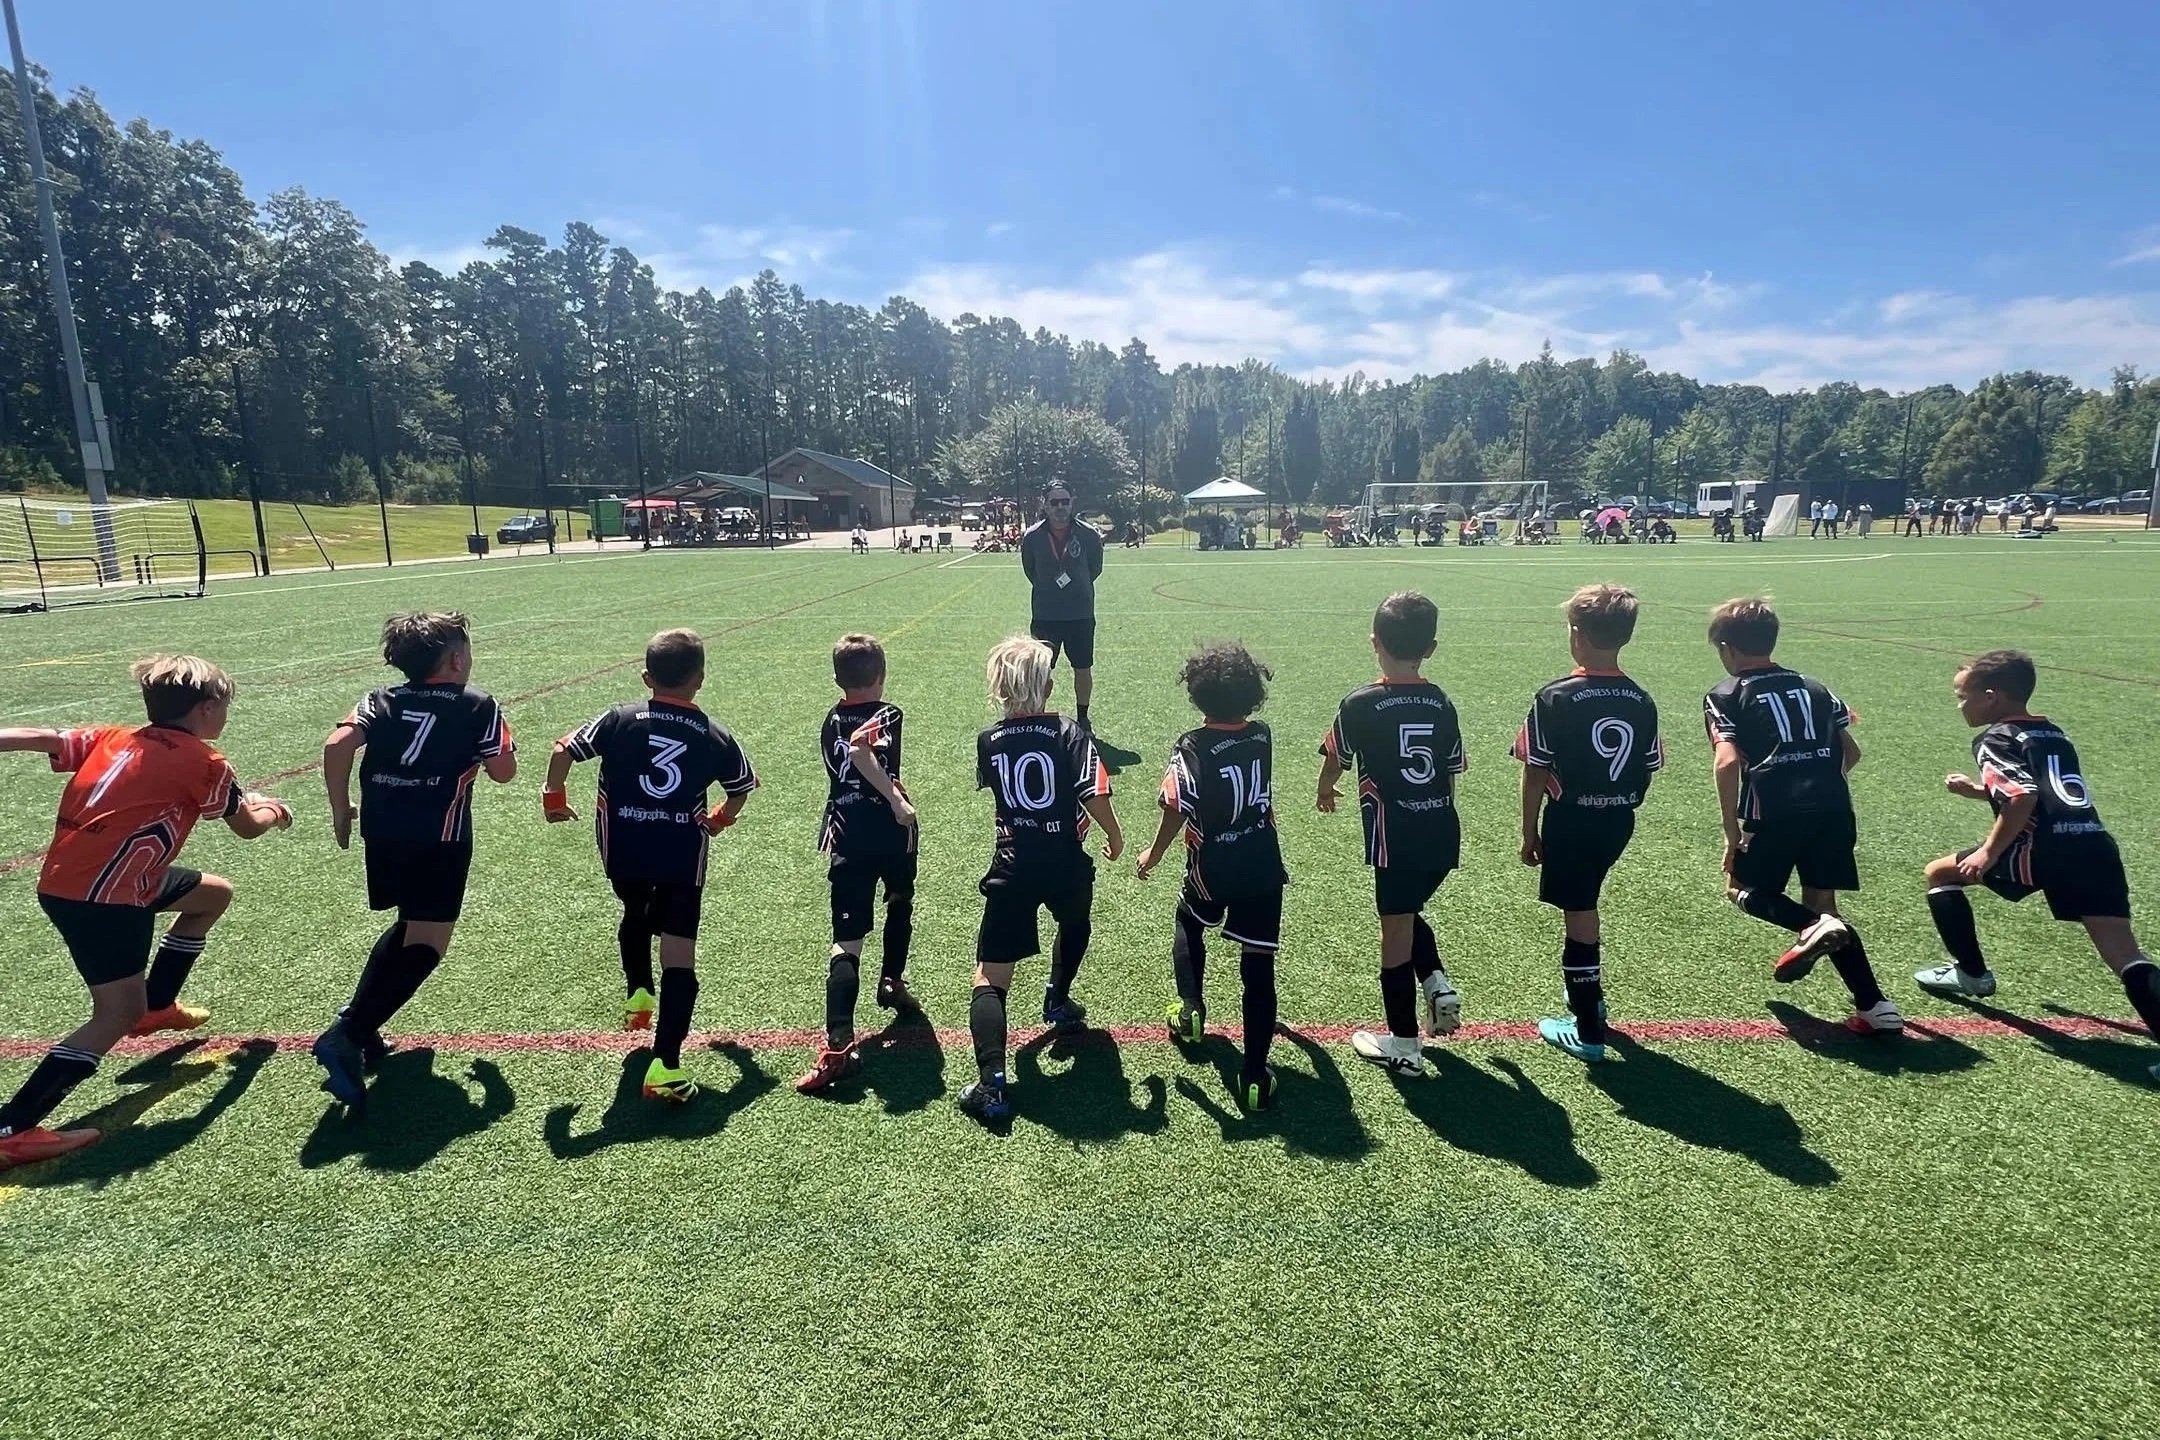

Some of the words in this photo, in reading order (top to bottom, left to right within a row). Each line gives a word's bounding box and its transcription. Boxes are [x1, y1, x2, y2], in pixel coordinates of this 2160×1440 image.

[696, 480, 703, 488] A
[798, 475, 804, 483] A
[635, 711, 674, 720] KINDNESS
[675, 715, 684, 723] IS
[684, 718, 708, 735] MAGIC
[1374, 696, 1413, 711] KINDNESS
[1413, 696, 1421, 704] IS
[1571, 688, 1611, 703] KINDNESS
[1612, 688, 1621, 696] IS
[1756, 688, 1816, 743] 11
[400, 709, 437, 767] 7
[990, 725, 1025, 742] KINDNESS
[1034, 725, 1058, 739] MAGIC
[1399, 723, 1436, 785] 5
[1591, 716, 1634, 781] 9
[85, 749, 136, 808] 1
[638, 734, 688, 799] 3
[990, 750, 1056, 811] 10
[1219, 758, 1271, 825] 14
[2047, 754, 2092, 809] 6
[675, 812, 689, 823] CLT
[1046, 820, 1061, 833] CLT
